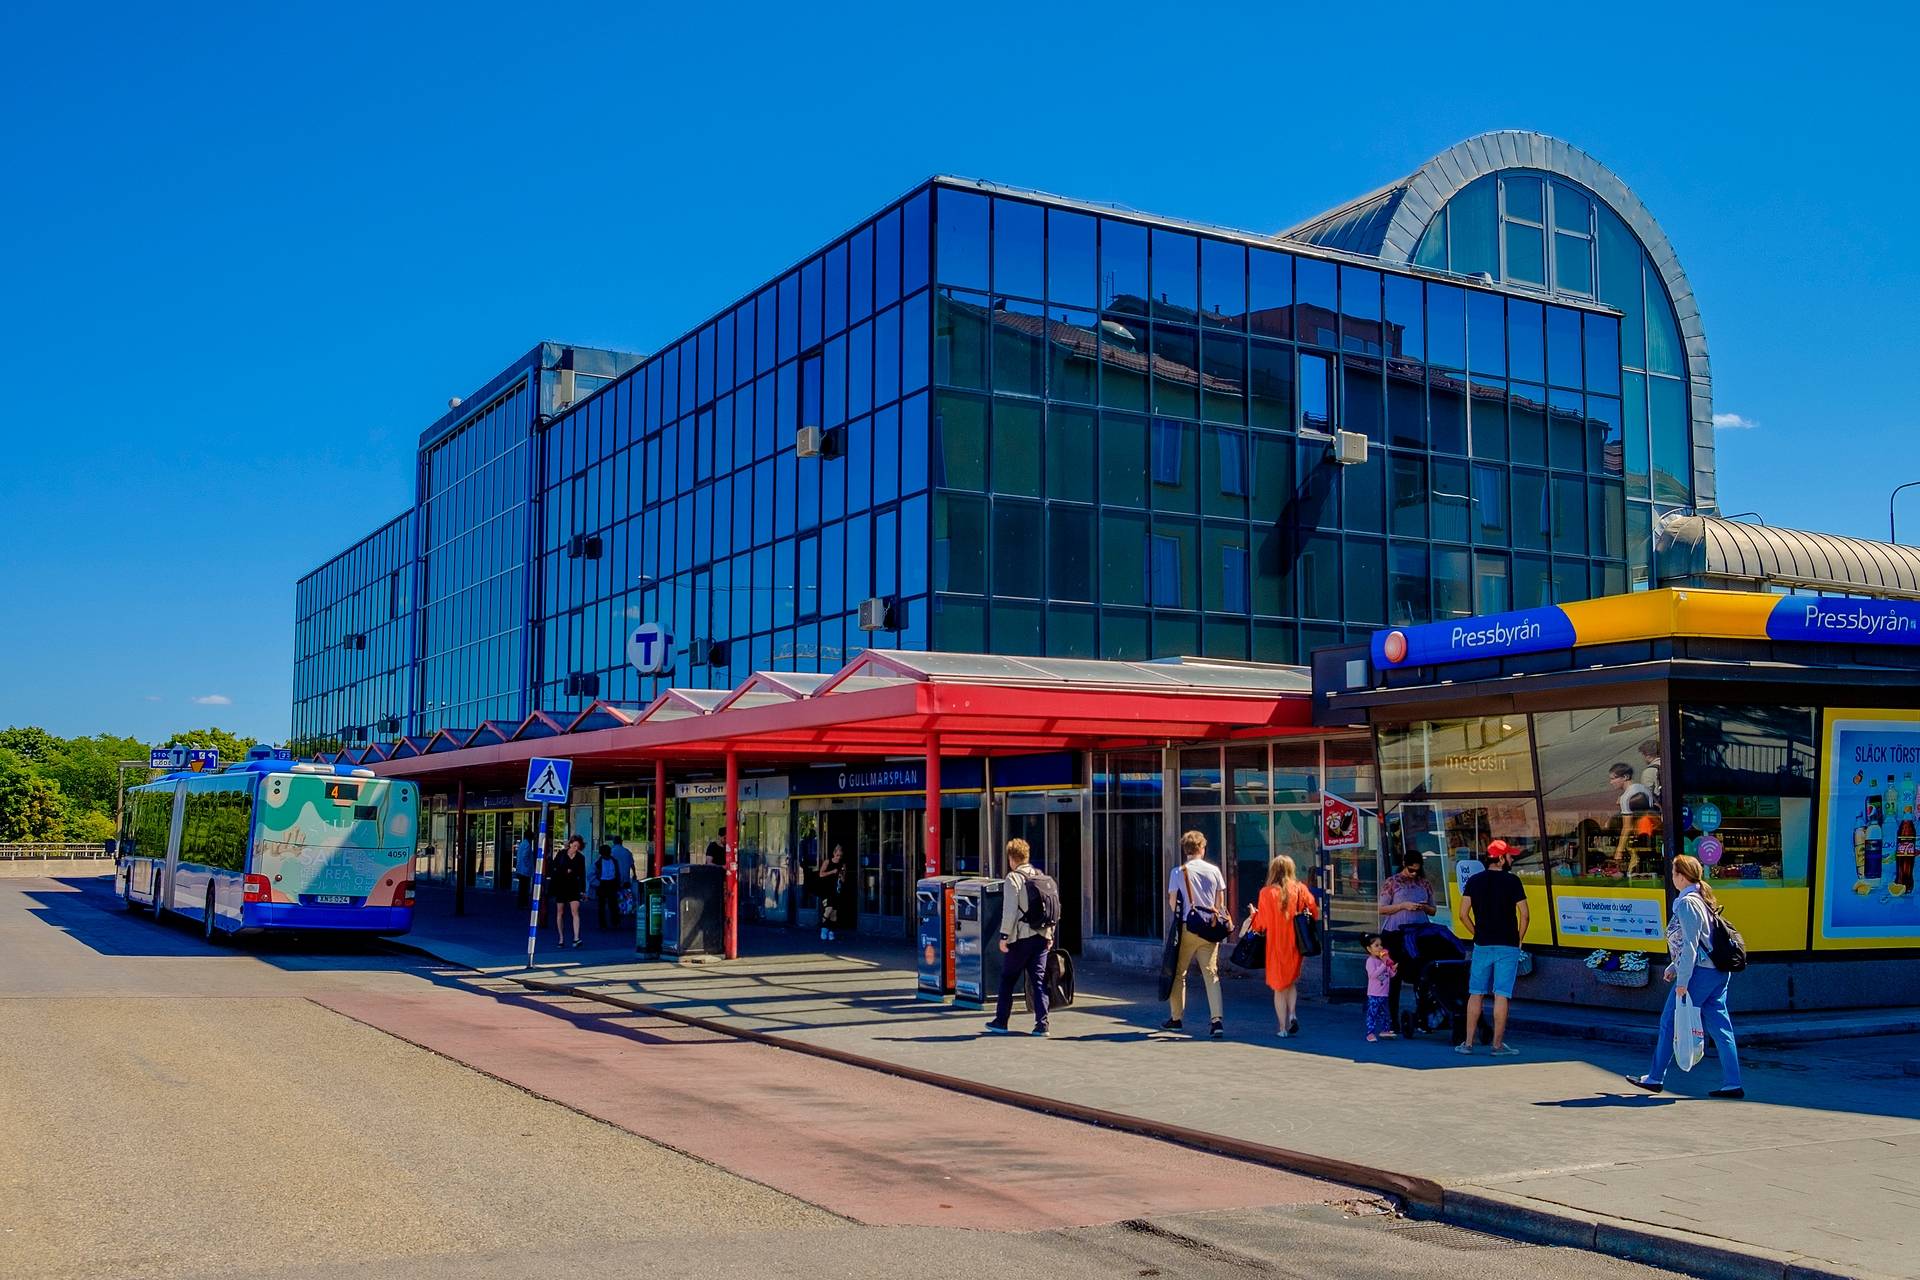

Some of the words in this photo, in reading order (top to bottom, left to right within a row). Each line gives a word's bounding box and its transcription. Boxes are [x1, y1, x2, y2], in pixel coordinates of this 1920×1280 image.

[1804, 604, 1909, 635] Pressbyrån
[1451, 618, 1540, 648] Pressbyrån
[636, 632, 657, 665] T
[172, 750, 184, 765] T
[1855, 744, 1887, 763] SLÄCK
[848, 769, 917, 787] GULLMARSPLAN
[331, 785, 339, 799] 4
[694, 785, 724, 794] Toalett
[301, 848, 353, 867] SALE
[387, 850, 408, 859] 4059
[1582, 901, 1592, 910] Vad
[1592, 901, 1612, 911] behöver
[1612, 903, 1619, 911] du
[1619, 903, 1633, 913] idag?
